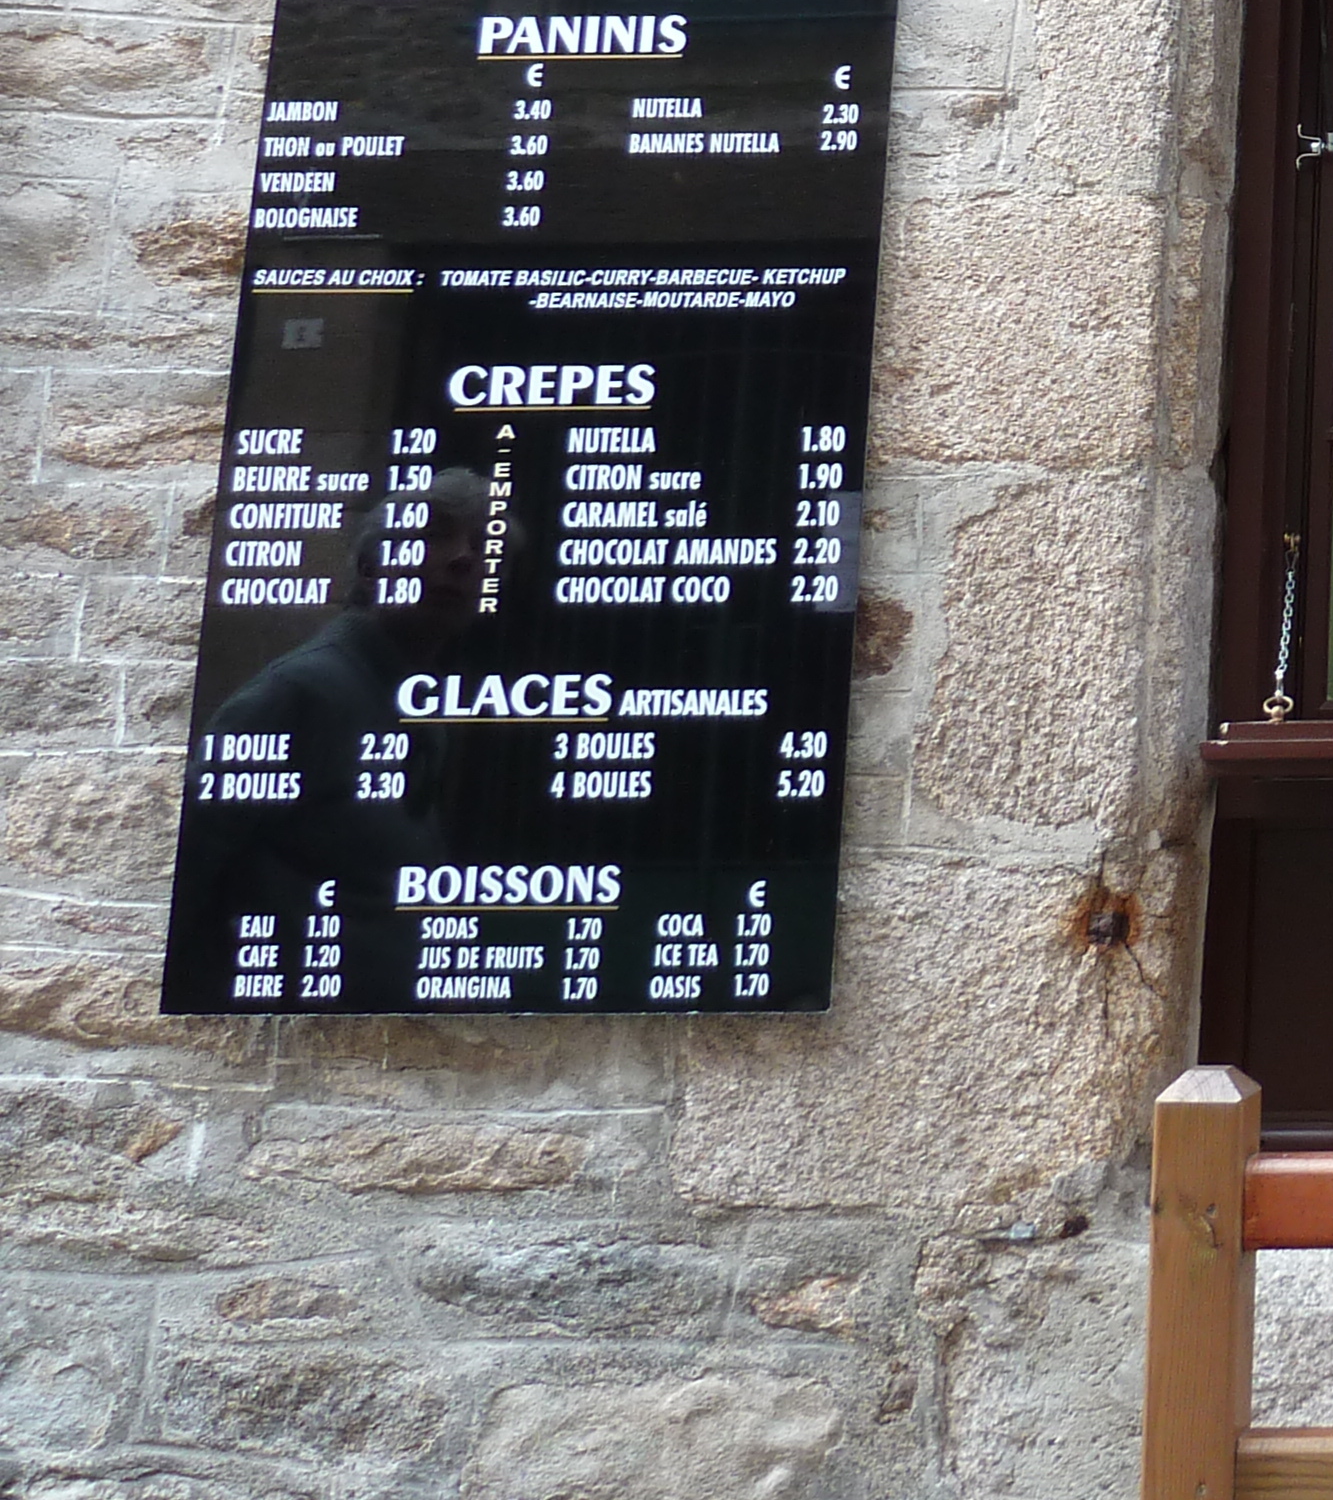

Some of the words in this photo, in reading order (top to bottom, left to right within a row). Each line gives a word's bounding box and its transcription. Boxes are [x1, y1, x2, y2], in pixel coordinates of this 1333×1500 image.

[478, 14, 687, 55] PANINIS
[265, 101, 339, 123] JAMBON
[513, 99, 552, 121] 3.40
[631, 97, 703, 119] NUTELLA
[821, 103, 860, 125] 2.30
[263, 136, 311, 158] THON
[314, 142, 336, 157] ou
[340, 135, 406, 157] POULET
[509, 134, 548, 156] 3.60
[628, 132, 705, 154] BANANES
[708, 132, 780, 154] NUTELLA
[819, 130, 858, 151] 2.90
[259, 171, 336, 193] VENDEEN
[505, 170, 545, 192] 3.60
[253, 207, 359, 229] BOLOGNAISE
[502, 205, 541, 227] 3.60
[253, 269, 327, 286] SAUCES
[326, 269, 356, 286] AU
[441, 269, 514, 287] TOMATE
[761, 268, 847, 285] KETCHUP
[448, 363, 656, 406] CREPES
[236, 428, 304, 456] SUCRE
[392, 427, 437, 455] 1.20
[567, 427, 656, 454] NUTELLA
[802, 425, 846, 452] 1.80
[231, 465, 312, 493] BEURRE
[315, 472, 370, 492] sucre
[389, 464, 433, 492] 1.50
[565, 464, 643, 491] CITRON
[648, 471, 702, 491] sucre
[799, 462, 843, 490] 1.90
[228, 502, 344, 530] CONFITURE
[385, 502, 429, 529] 1.60
[562, 501, 659, 528] CARAMEL
[664, 500, 707, 528] salé
[795, 500, 841, 527] 2.10
[224, 540, 303, 568] CITRON
[381, 539, 426, 567] 1.60
[559, 538, 669, 566] CHOCOLAT
[673, 537, 777, 565] AMANDES
[793, 537, 842, 565] 2.20
[220, 577, 332, 605] CHOCOLAT
[377, 577, 422, 605] 1.80
[555, 576, 666, 604] CHOCOLAT
[671, 575, 731, 603] COCO
[790, 575, 839, 603] 2.20
[397, 673, 613, 717] GLACES
[618, 689, 768, 717] ARTISANALES
[204, 734, 215, 762] 1
[221, 733, 291, 762] BOULE
[359, 733, 409, 761] 2.20
[553, 732, 569, 760] 3
[575, 731, 655, 760] BOULES
[779, 731, 828, 759] 4.30
[198, 772, 215, 801] 2
[220, 772, 301, 800] BOULES
[356, 771, 405, 800] 3.30
[550, 771, 565, 799] 4
[572, 770, 652, 799] BOULES
[777, 769, 825, 798] 5.20
[396, 864, 621, 904] BOISSONS
[239, 915, 276, 939] EAU
[307, 915, 341, 938] 1.10
[421, 916, 479, 940] SODAS
[567, 917, 603, 941] 1.70
[657, 913, 704, 937] COCA
[736, 913, 772, 937] 1.70
[237, 944, 279, 968] CAFE
[304, 944, 341, 968] 1.20
[417, 946, 451, 970] JUS
[456, 946, 481, 970] DE
[484, 946, 544, 970] FRUITS
[565, 947, 600, 970] 1.70
[654, 943, 683, 967] ICE
[687, 943, 719, 967] TEA
[734, 943, 770, 967] 1.70
[233, 974, 284, 998] BIERE
[300, 974, 342, 998] 2.00
[416, 975, 511, 1000] ORANGINA
[562, 976, 598, 1000] 1.70
[649, 975, 701, 999] OASIS
[734, 973, 770, 997] 1.70
